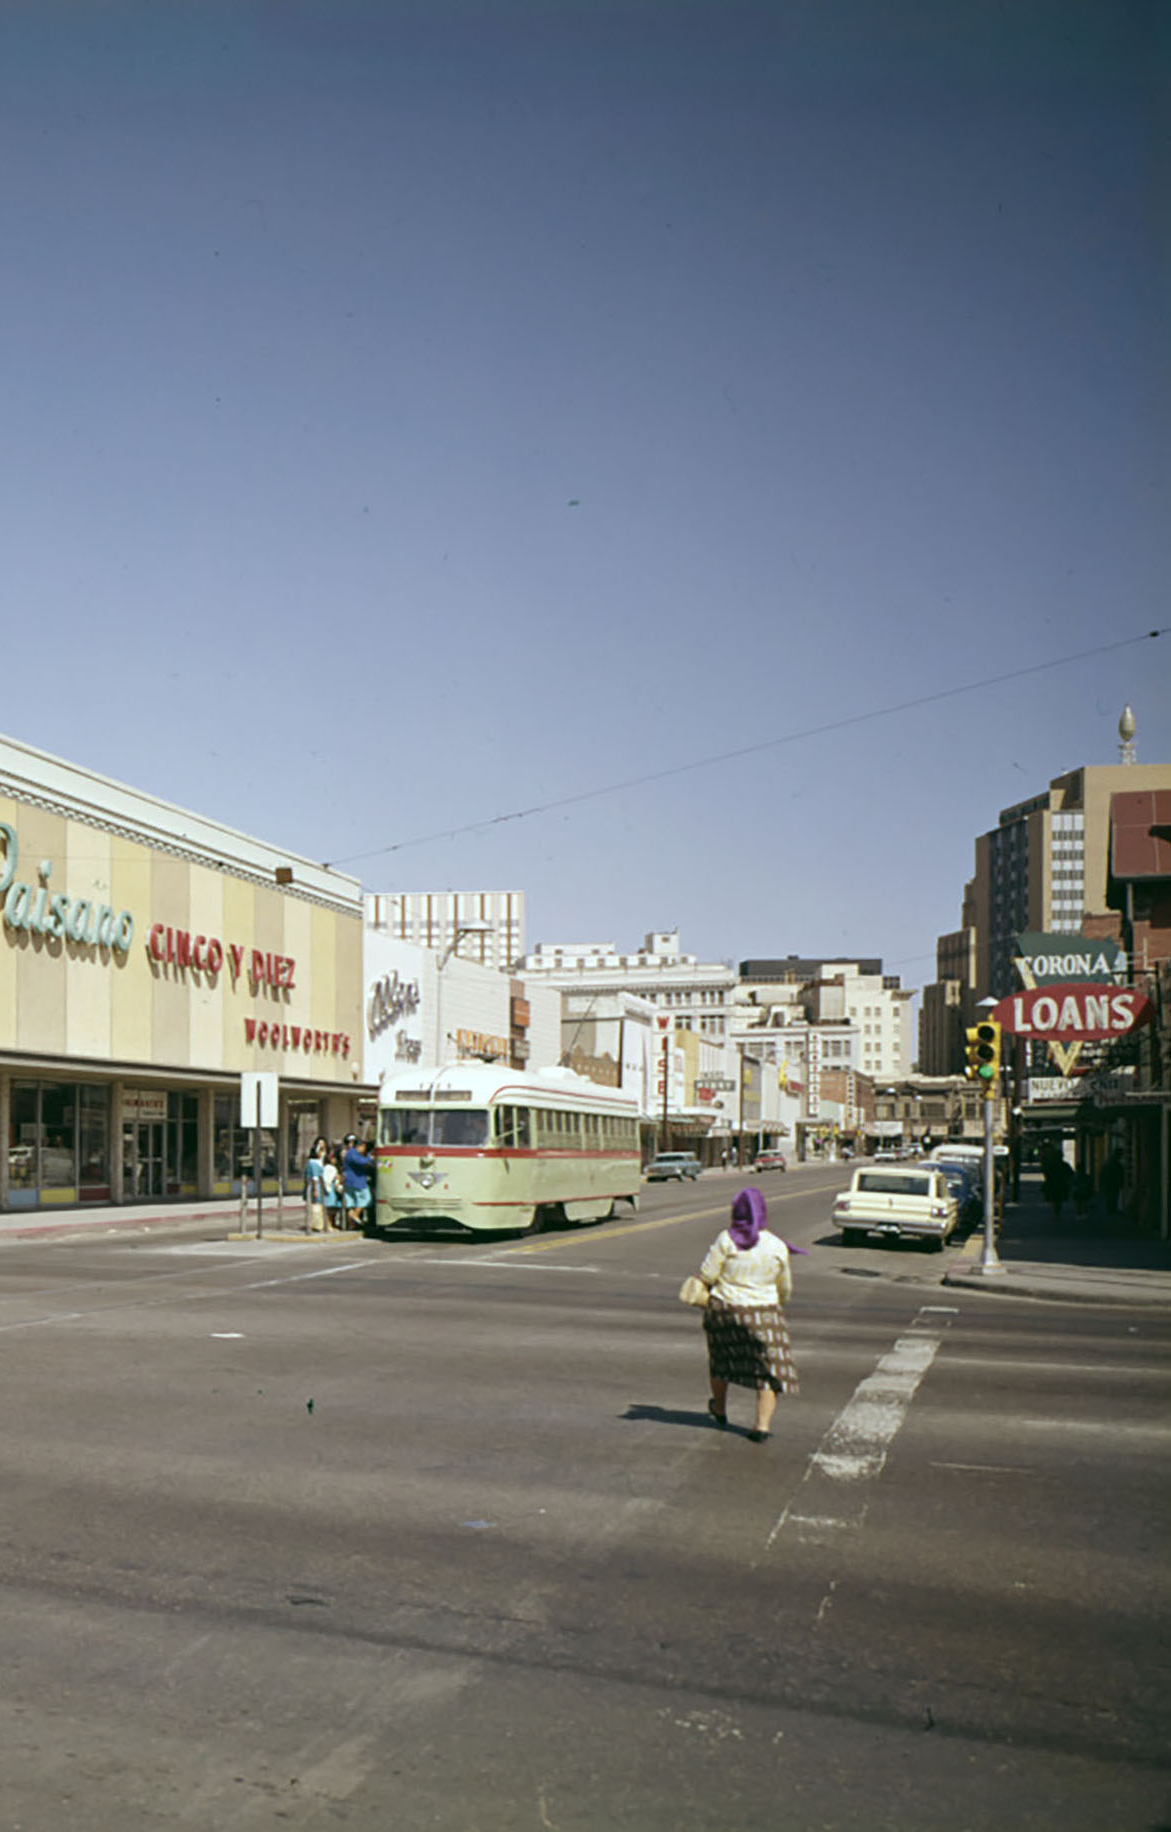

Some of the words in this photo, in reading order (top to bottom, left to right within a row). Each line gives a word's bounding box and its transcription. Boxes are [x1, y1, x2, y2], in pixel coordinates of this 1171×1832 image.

[149, 923, 223, 974] CINCO
[229, 943, 244, 979] Y
[251, 949, 296, 989] DIEZ
[1021, 953, 1110, 977] CORONA
[1014, 994, 1134, 1032] LOANS
[244, 1018, 351, 1060] WOOLWORTH'S
